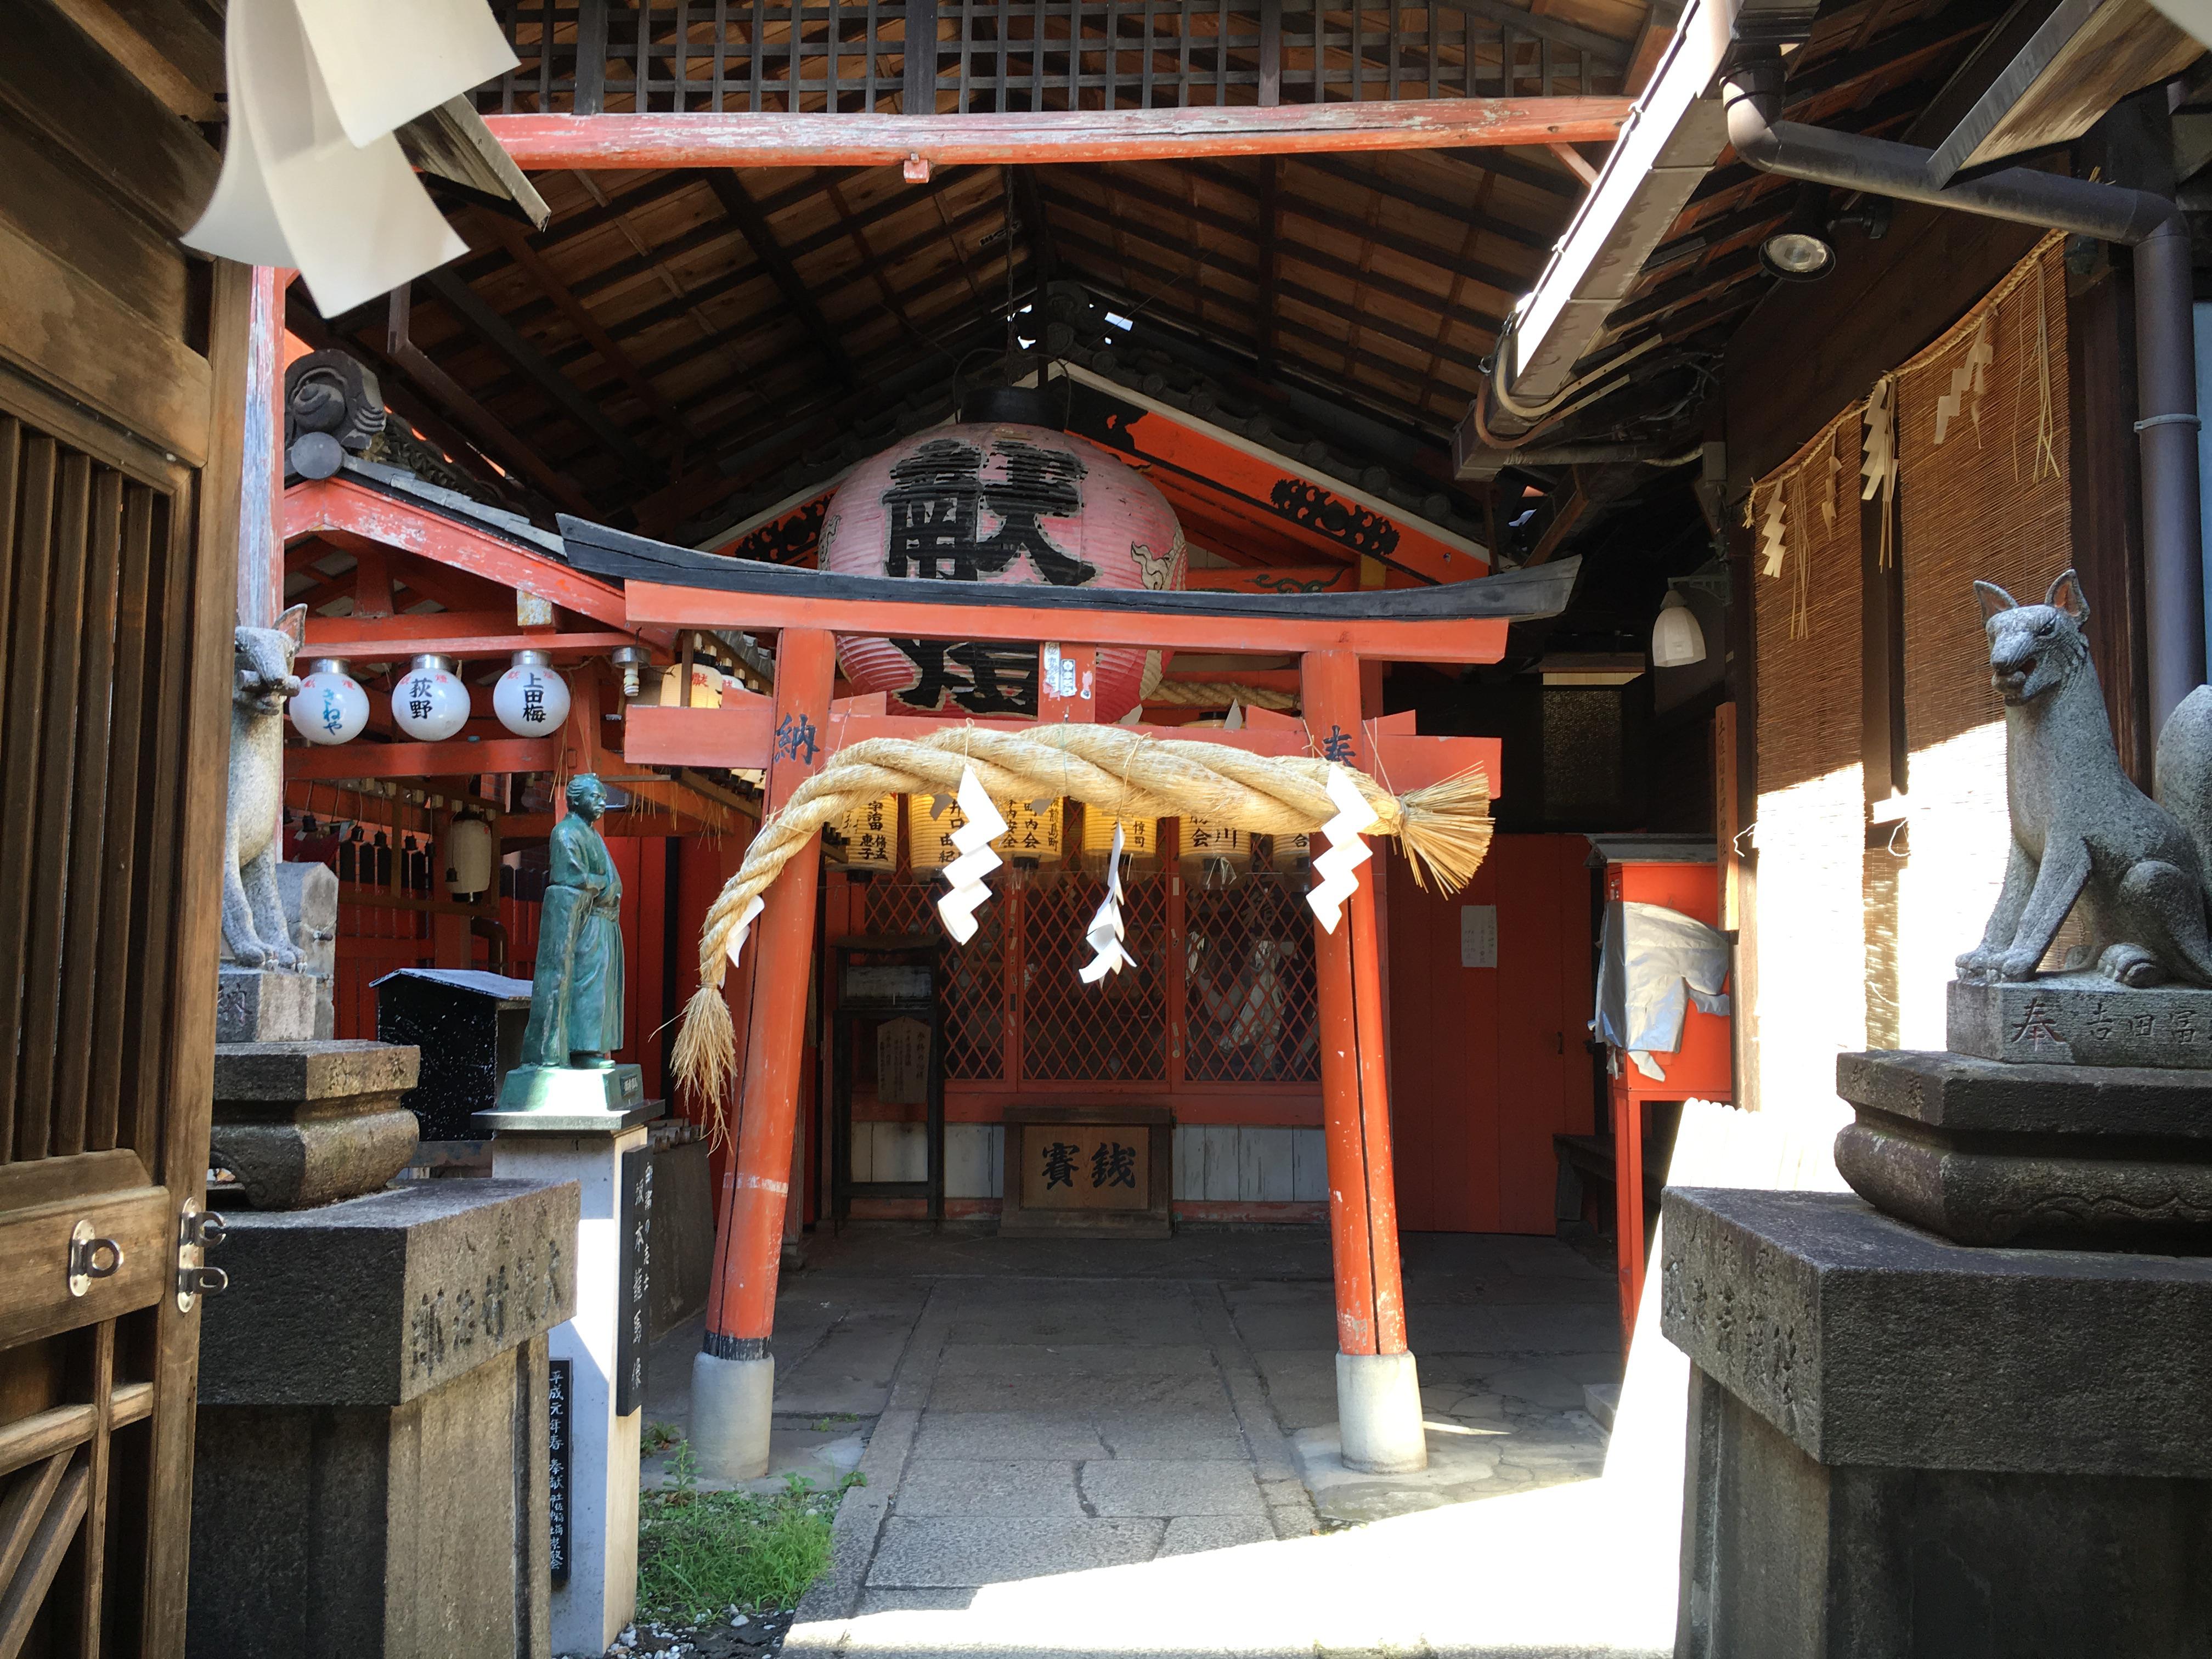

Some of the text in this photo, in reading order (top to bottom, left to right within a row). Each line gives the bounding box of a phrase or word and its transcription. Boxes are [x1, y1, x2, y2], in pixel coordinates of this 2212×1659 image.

[323, 688, 342, 736] きねや
[409, 677, 433, 719] 荻野
[523, 673, 546, 723] 上田梅
[775, 712, 820, 765] 納
[867, 800, 884, 831] 宇治田
[2010, 998, 2066, 1051] 奉
[1042, 1142, 1136, 1190] 賽銭
